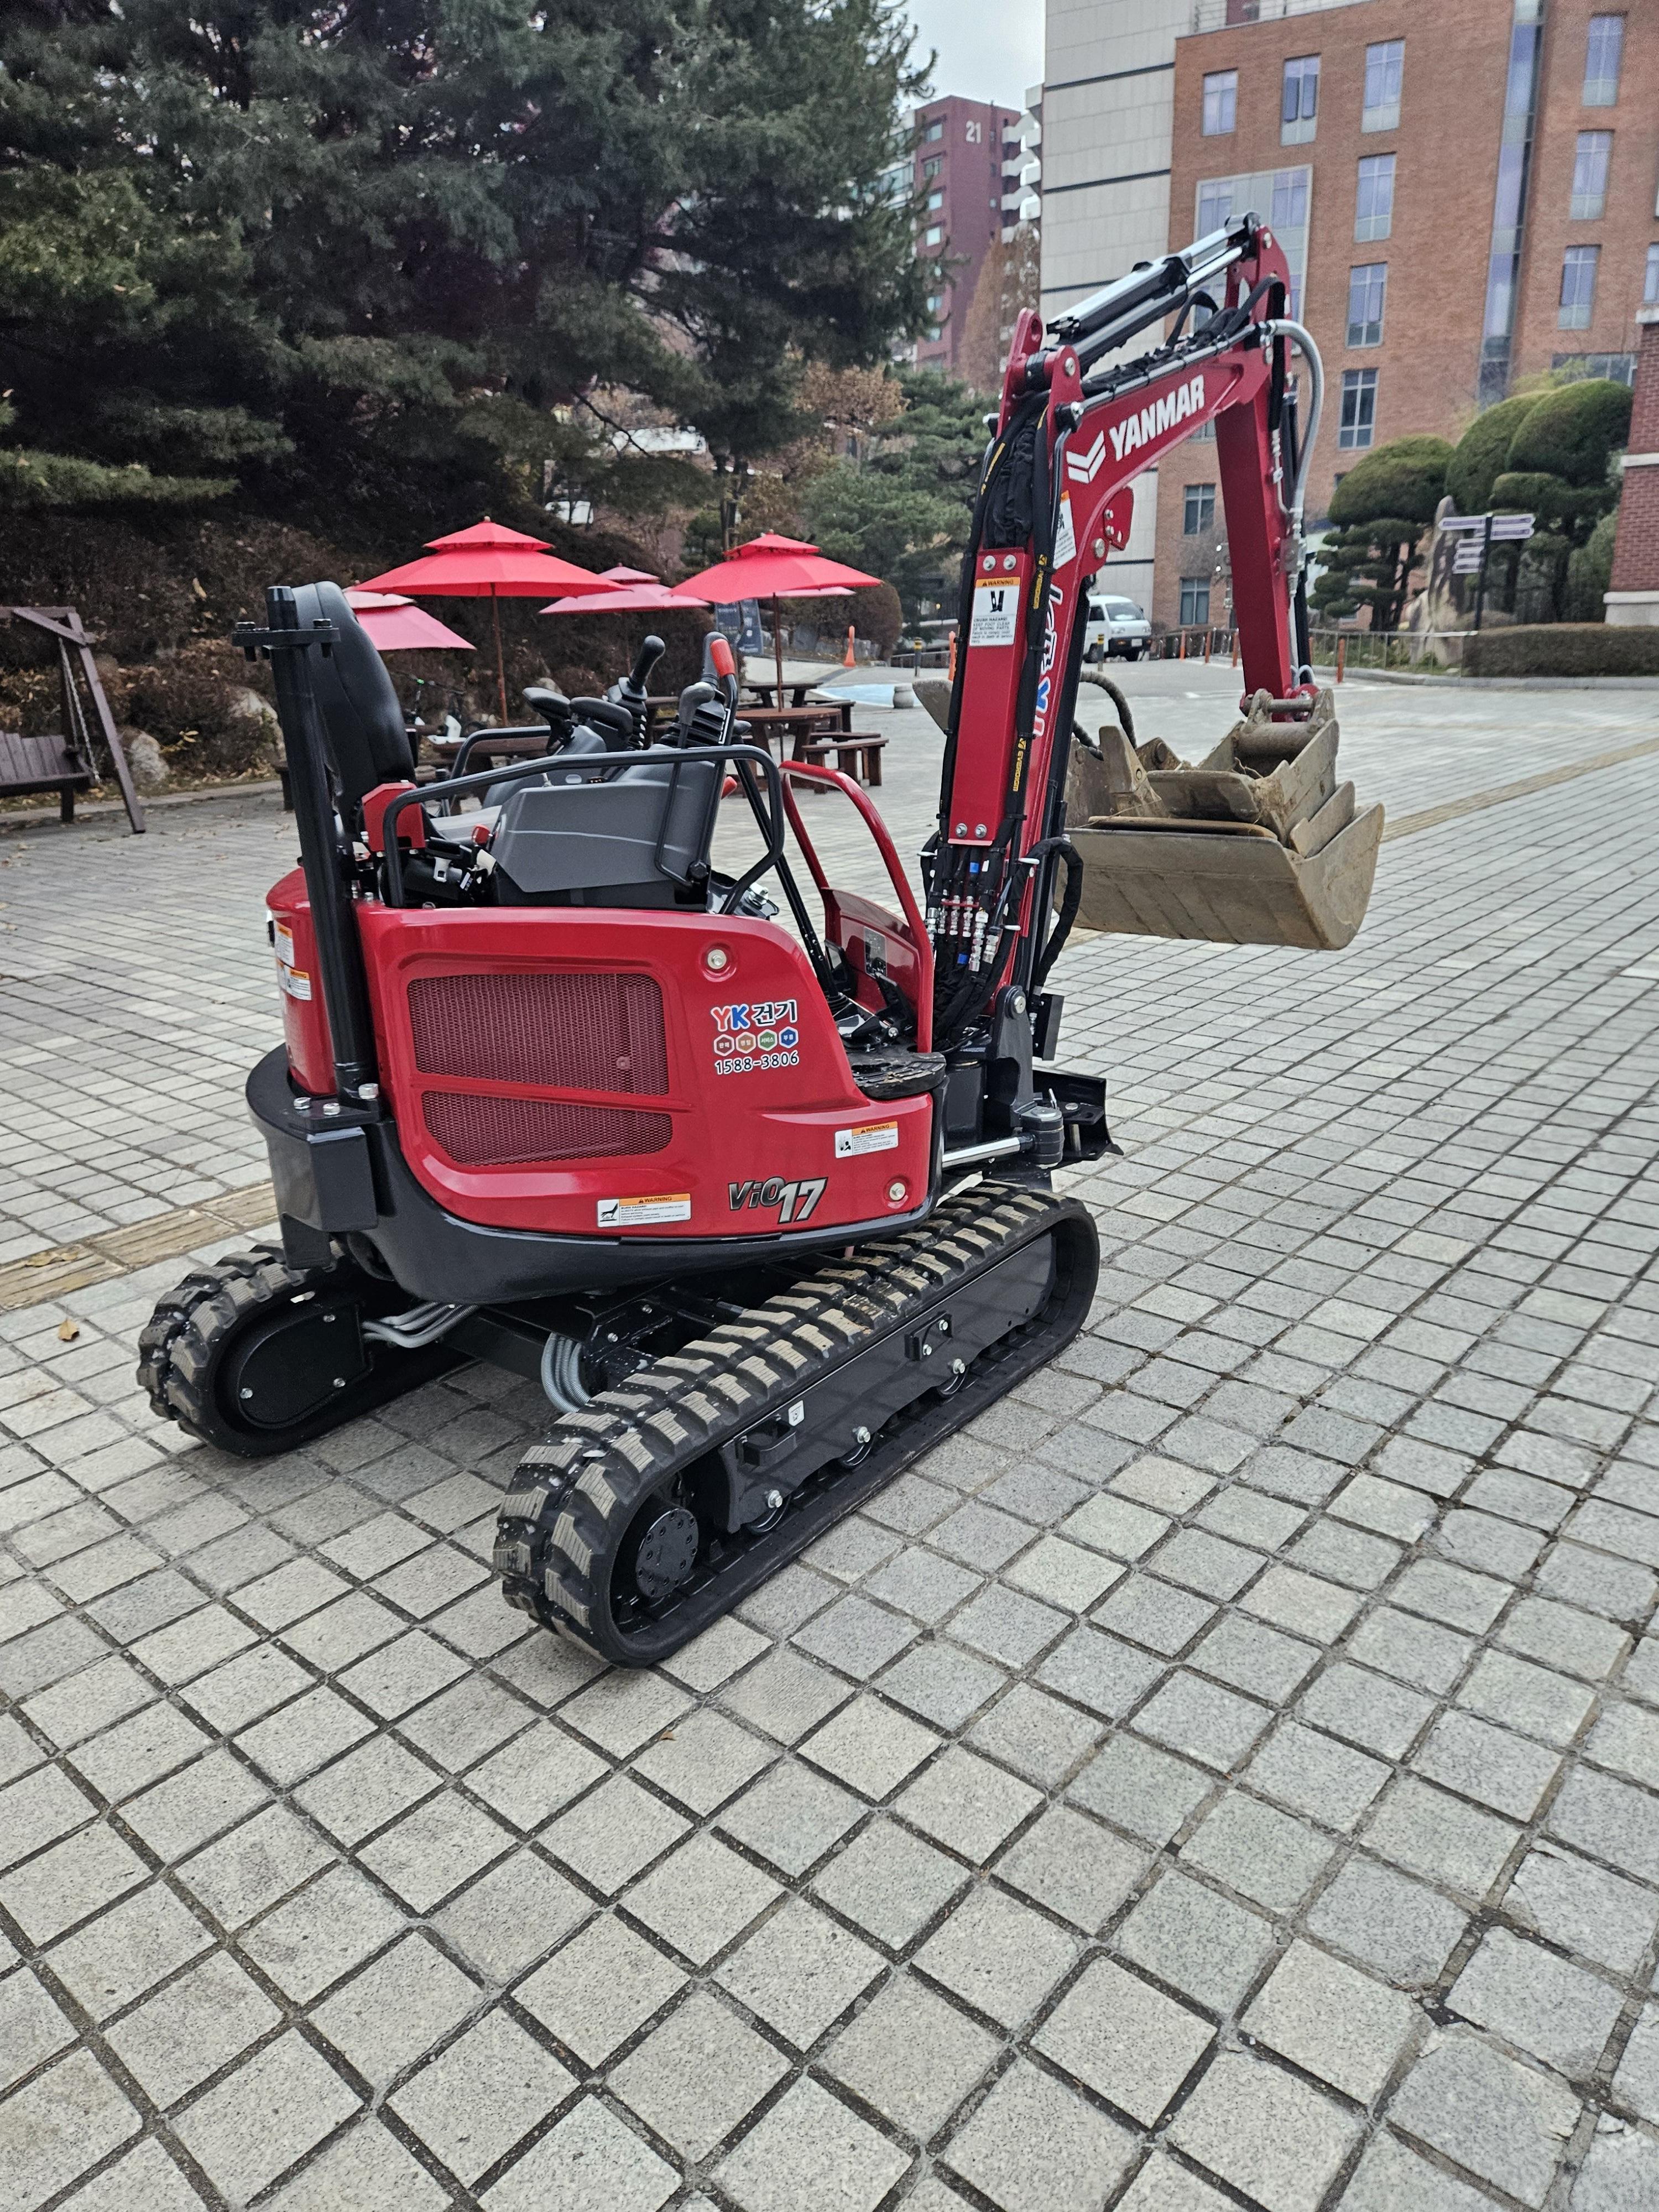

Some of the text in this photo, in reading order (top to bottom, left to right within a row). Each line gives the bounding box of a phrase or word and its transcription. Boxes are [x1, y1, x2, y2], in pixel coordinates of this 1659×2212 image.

[966, 120, 981, 144] 21
[1109, 375, 1204, 462] YANMAR
[712, 1001, 796, 1030] YK 건기
[716, 1051, 799, 1074] 1588-3806
